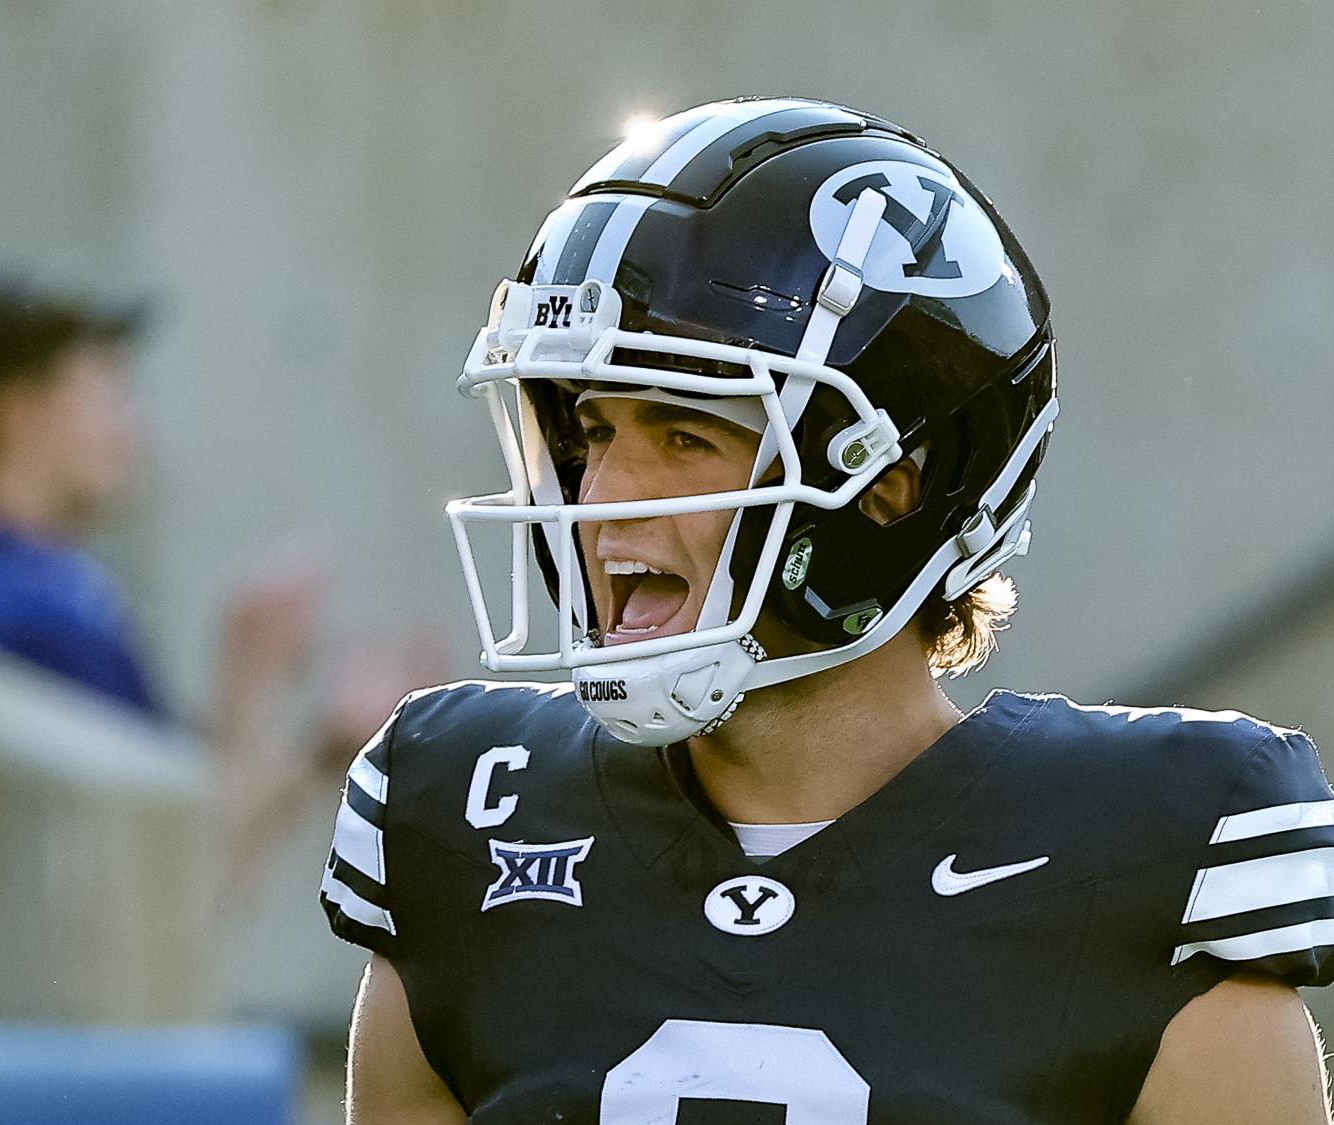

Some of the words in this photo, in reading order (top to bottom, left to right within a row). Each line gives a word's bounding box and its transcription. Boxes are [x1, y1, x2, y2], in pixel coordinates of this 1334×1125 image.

[832, 173, 964, 279] Y
[590, 680, 627, 701] COUGS
[465, 744, 530, 829] C
[489, 846, 585, 900] XII
[720, 885, 779, 925] Y
